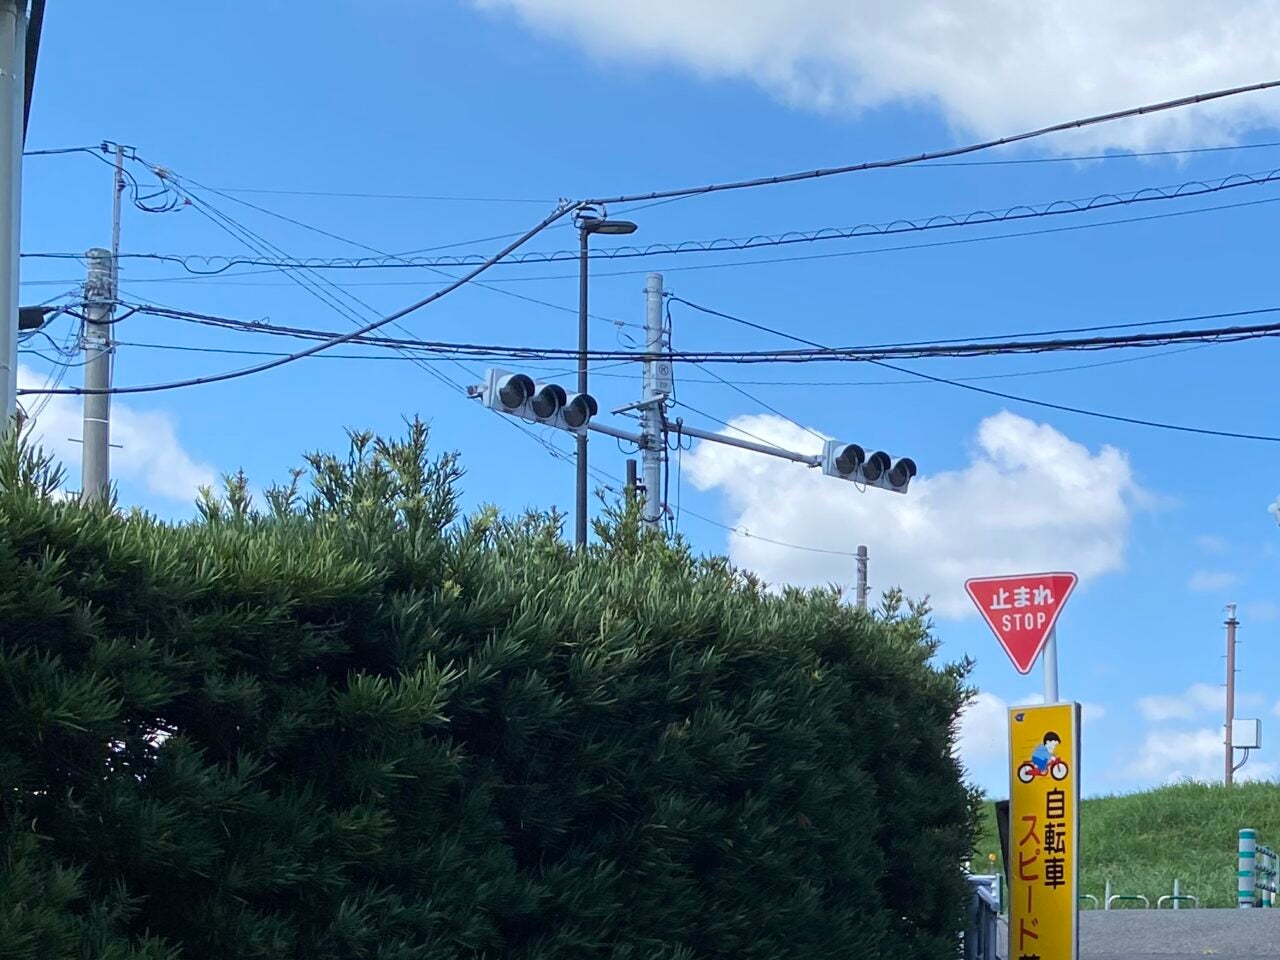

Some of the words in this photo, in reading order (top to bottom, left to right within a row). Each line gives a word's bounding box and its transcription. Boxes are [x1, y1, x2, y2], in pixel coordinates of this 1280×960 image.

[990, 585, 1054, 610] 止まれ
[1002, 612, 1046, 631] STOP
[1044, 787, 1066, 890] 自転車
